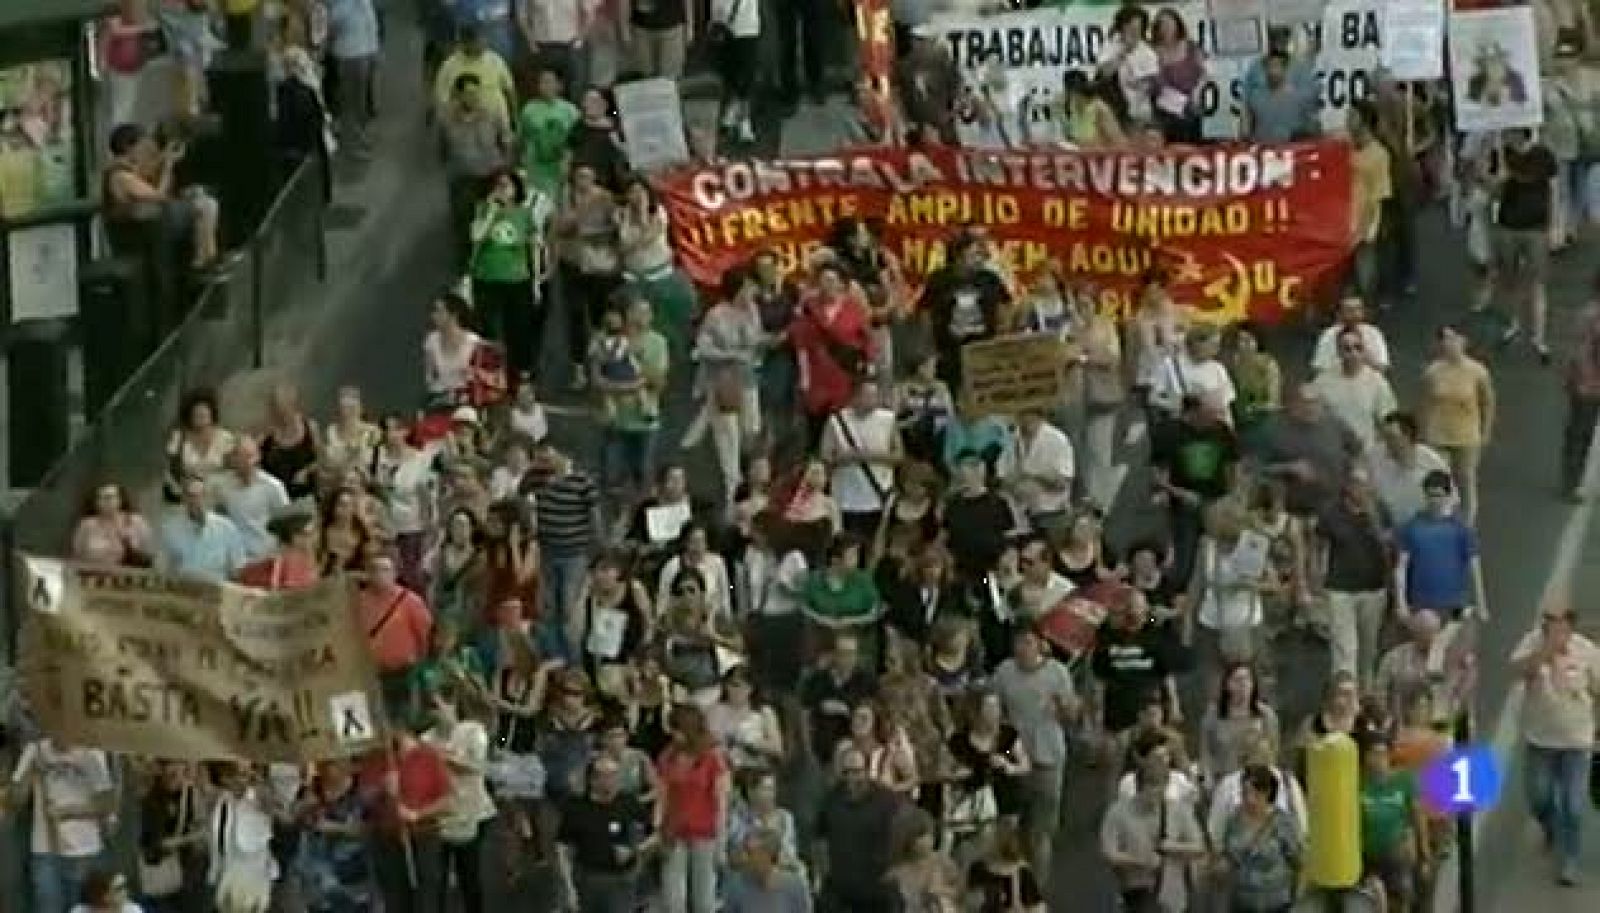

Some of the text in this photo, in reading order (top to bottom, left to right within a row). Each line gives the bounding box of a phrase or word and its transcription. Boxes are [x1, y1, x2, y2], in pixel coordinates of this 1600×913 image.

[692, 157, 882, 209] CONTRA
[1042, 197, 1089, 230] DE
[82, 676, 203, 728] BASTA
